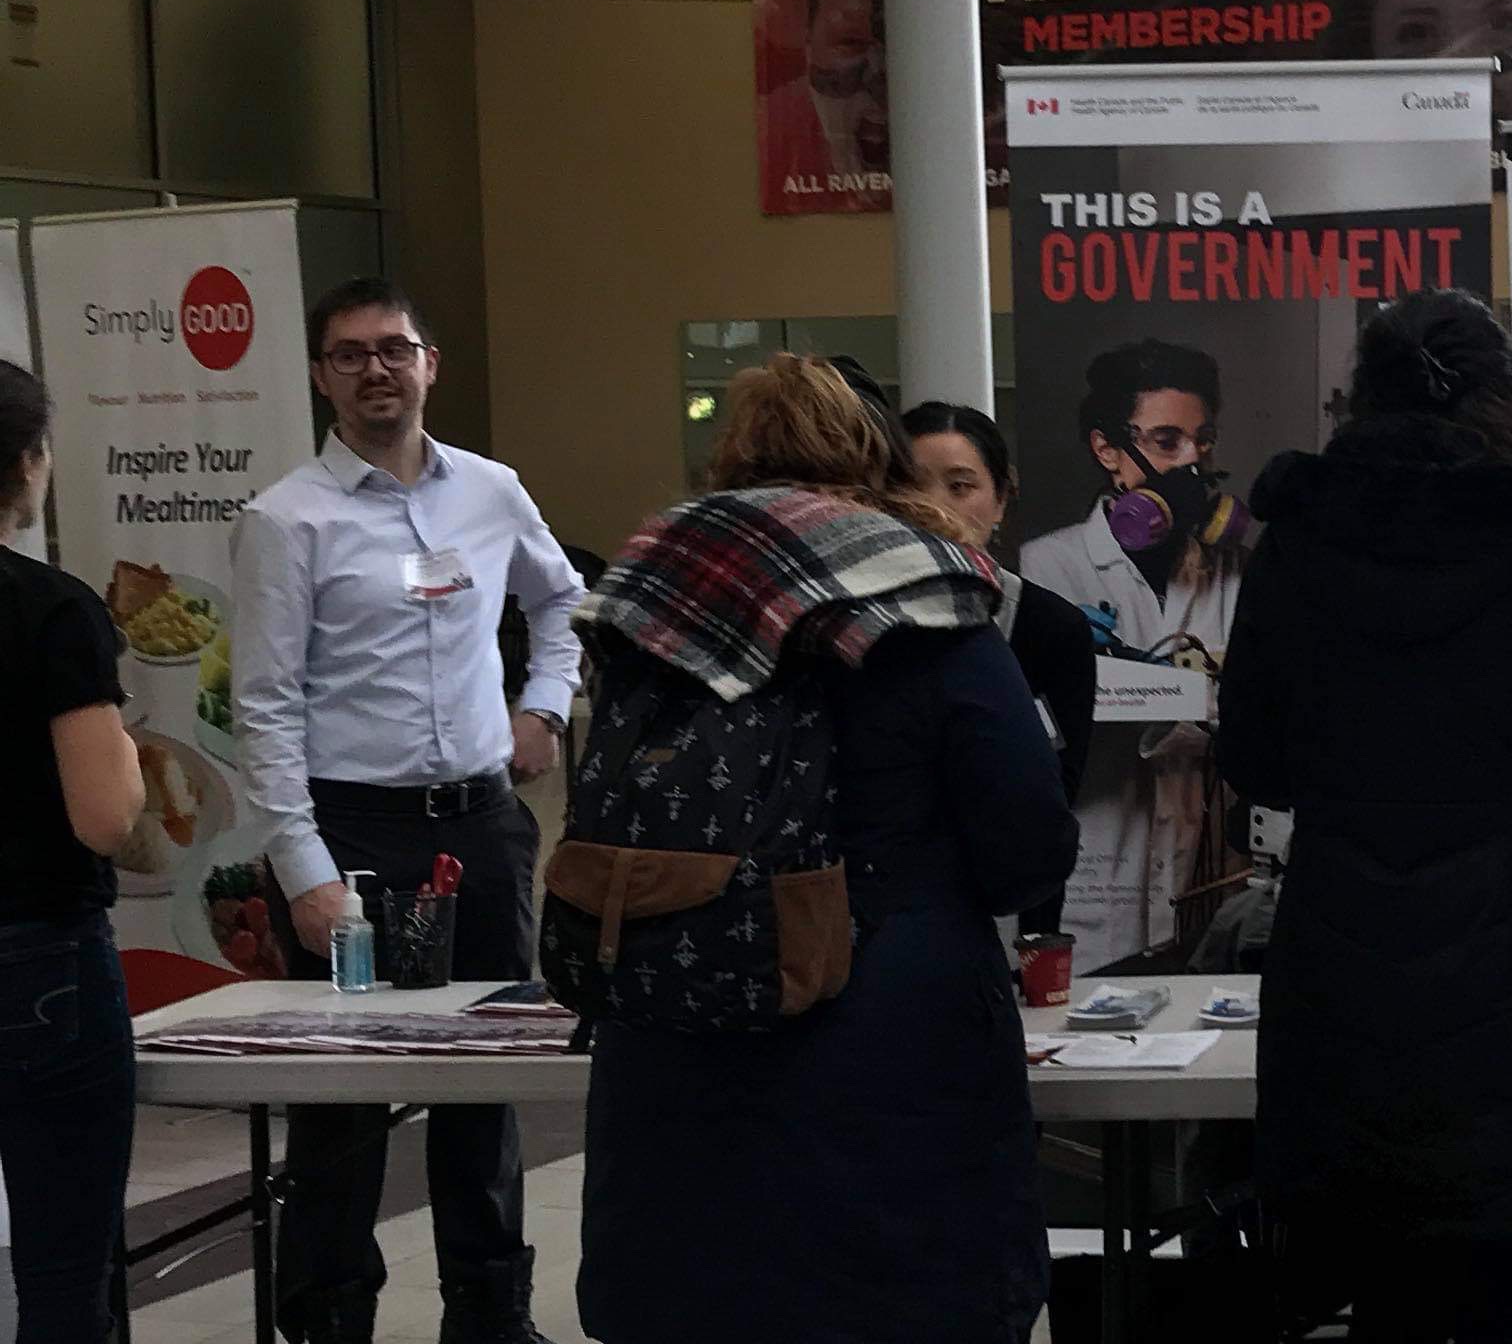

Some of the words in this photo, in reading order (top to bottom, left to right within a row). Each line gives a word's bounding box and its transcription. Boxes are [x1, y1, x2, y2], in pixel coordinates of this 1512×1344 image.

[1023, 1, 1333, 54] MEMBERSHIP
[1401, 90, 1471, 110] Canada
[783, 174, 824, 194] ALL
[1041, 192, 1158, 228] THIS
[1175, 191, 1224, 227] IS
[1237, 191, 1274, 227] A
[1040, 227, 1463, 304] GOVERNMENT
[84, 299, 175, 344] Simply
[184, 303, 250, 335] GOOD
[106, 442, 190, 482] Inspire
[194, 442, 253, 474] Your
